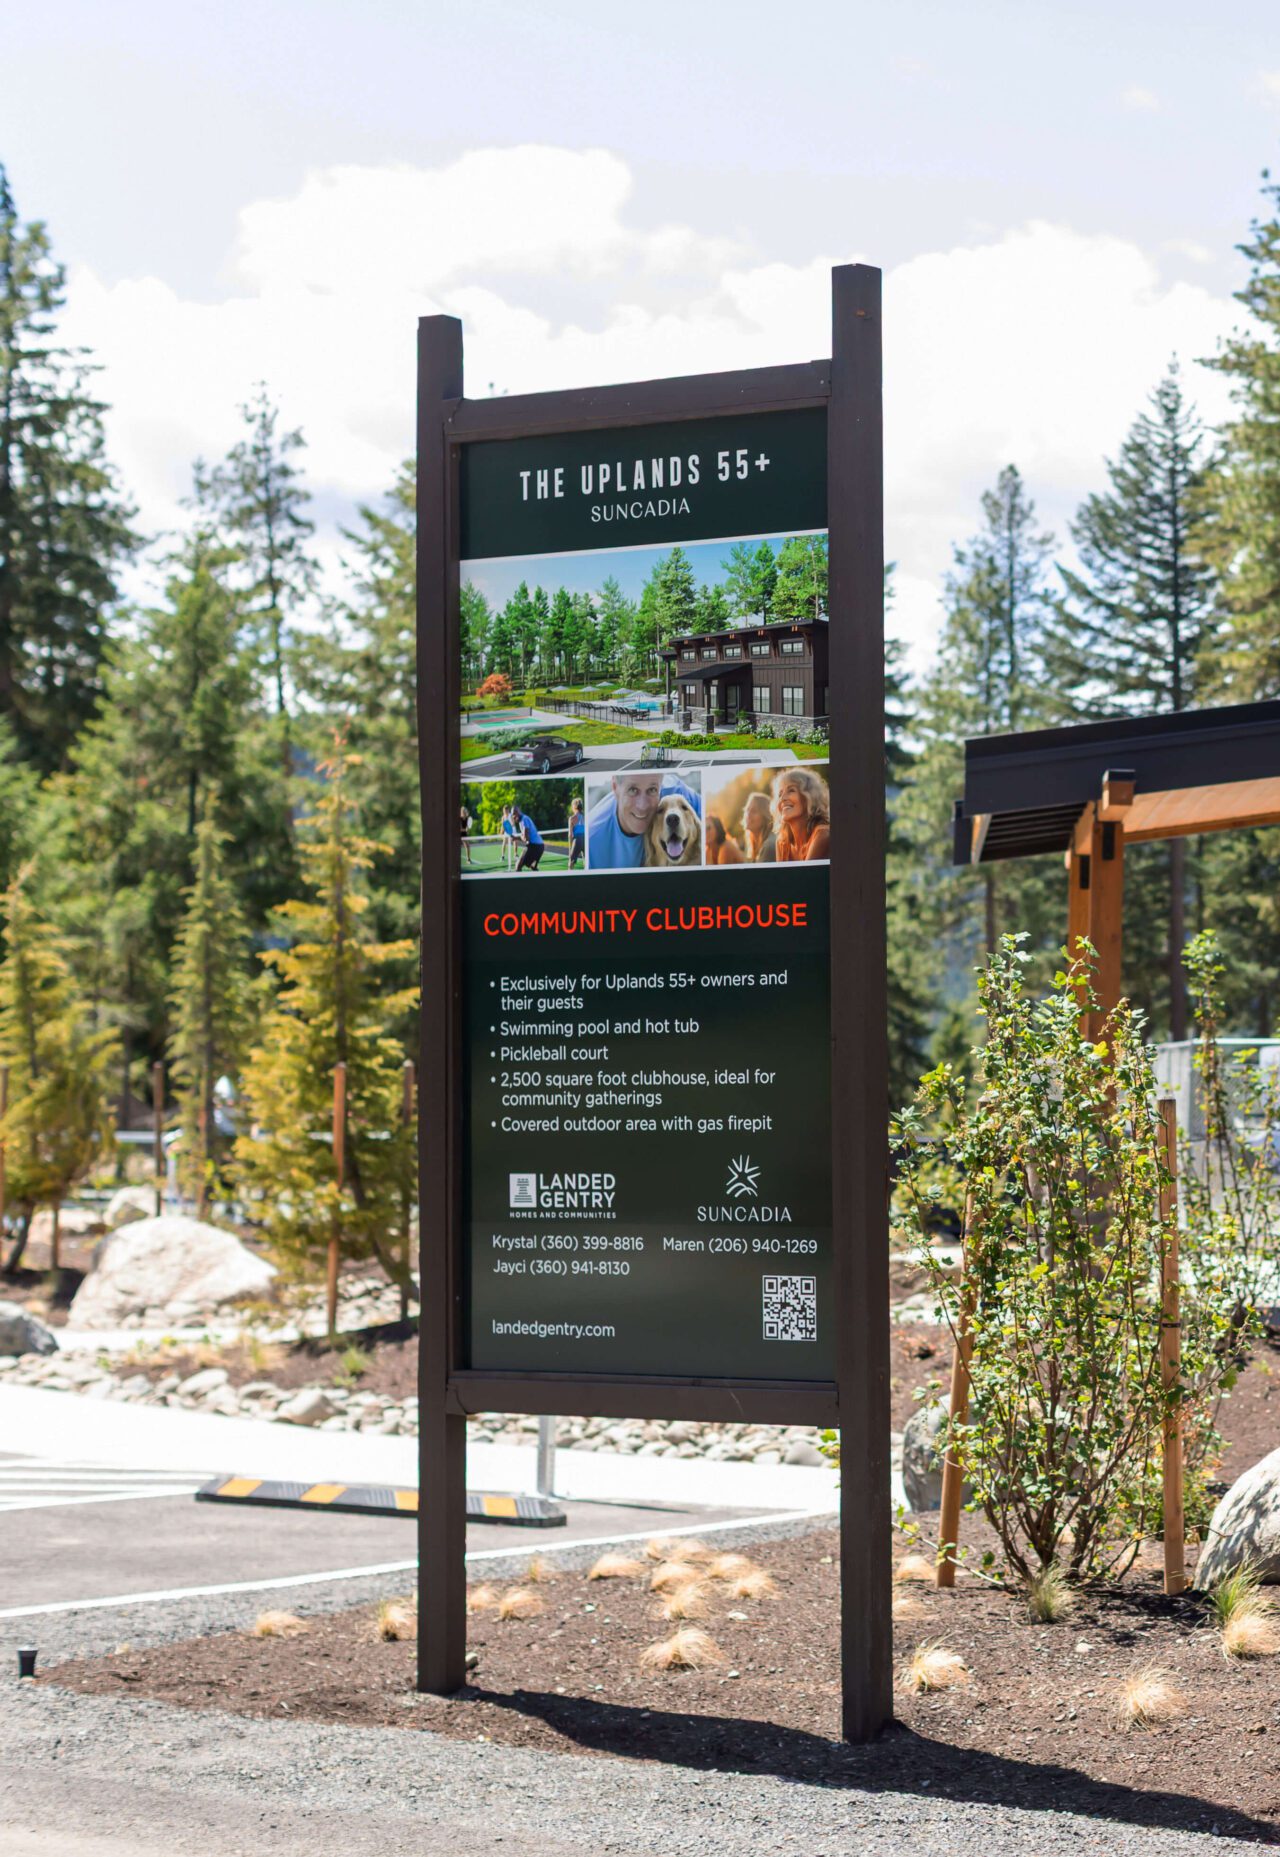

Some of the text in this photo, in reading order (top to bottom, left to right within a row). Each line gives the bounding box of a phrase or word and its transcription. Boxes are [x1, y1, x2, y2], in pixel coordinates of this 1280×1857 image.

[519, 448, 771, 501] THE UPLANDS 55+
[590, 497, 691, 523] SUNCADIA
[483, 902, 808, 937] COMMUNITY CLUBHOUSE
[500, 969, 788, 993] Exclusively for Uplands 55+ owners and
[500, 994, 584, 1013] their guests
[500, 1017, 700, 1038] Swimming pool and hot tub
[500, 1044, 609, 1062] Pickleball court
[500, 1068, 776, 1089] 2,500 square foot clubhouse, ideal for
[501, 1089, 663, 1109] community gatherings
[501, 1114, 773, 1134] Covered outdoor area with gas firepit
[539, 1173, 616, 1190] LANDED
[539, 1190, 616, 1209] GENTRY
[509, 1211, 617, 1219] HOMES AND COMMUNITIES
[696, 1205, 792, 1222] SUNCADIA
[492, 1234, 645, 1252] Krystal (360) 399-8816
[663, 1236, 818, 1255] Maren (206) 940-1269
[492, 1259, 631, 1276] Jayci (360) 941-8130
[492, 1319, 616, 1339] landedgentry.com
